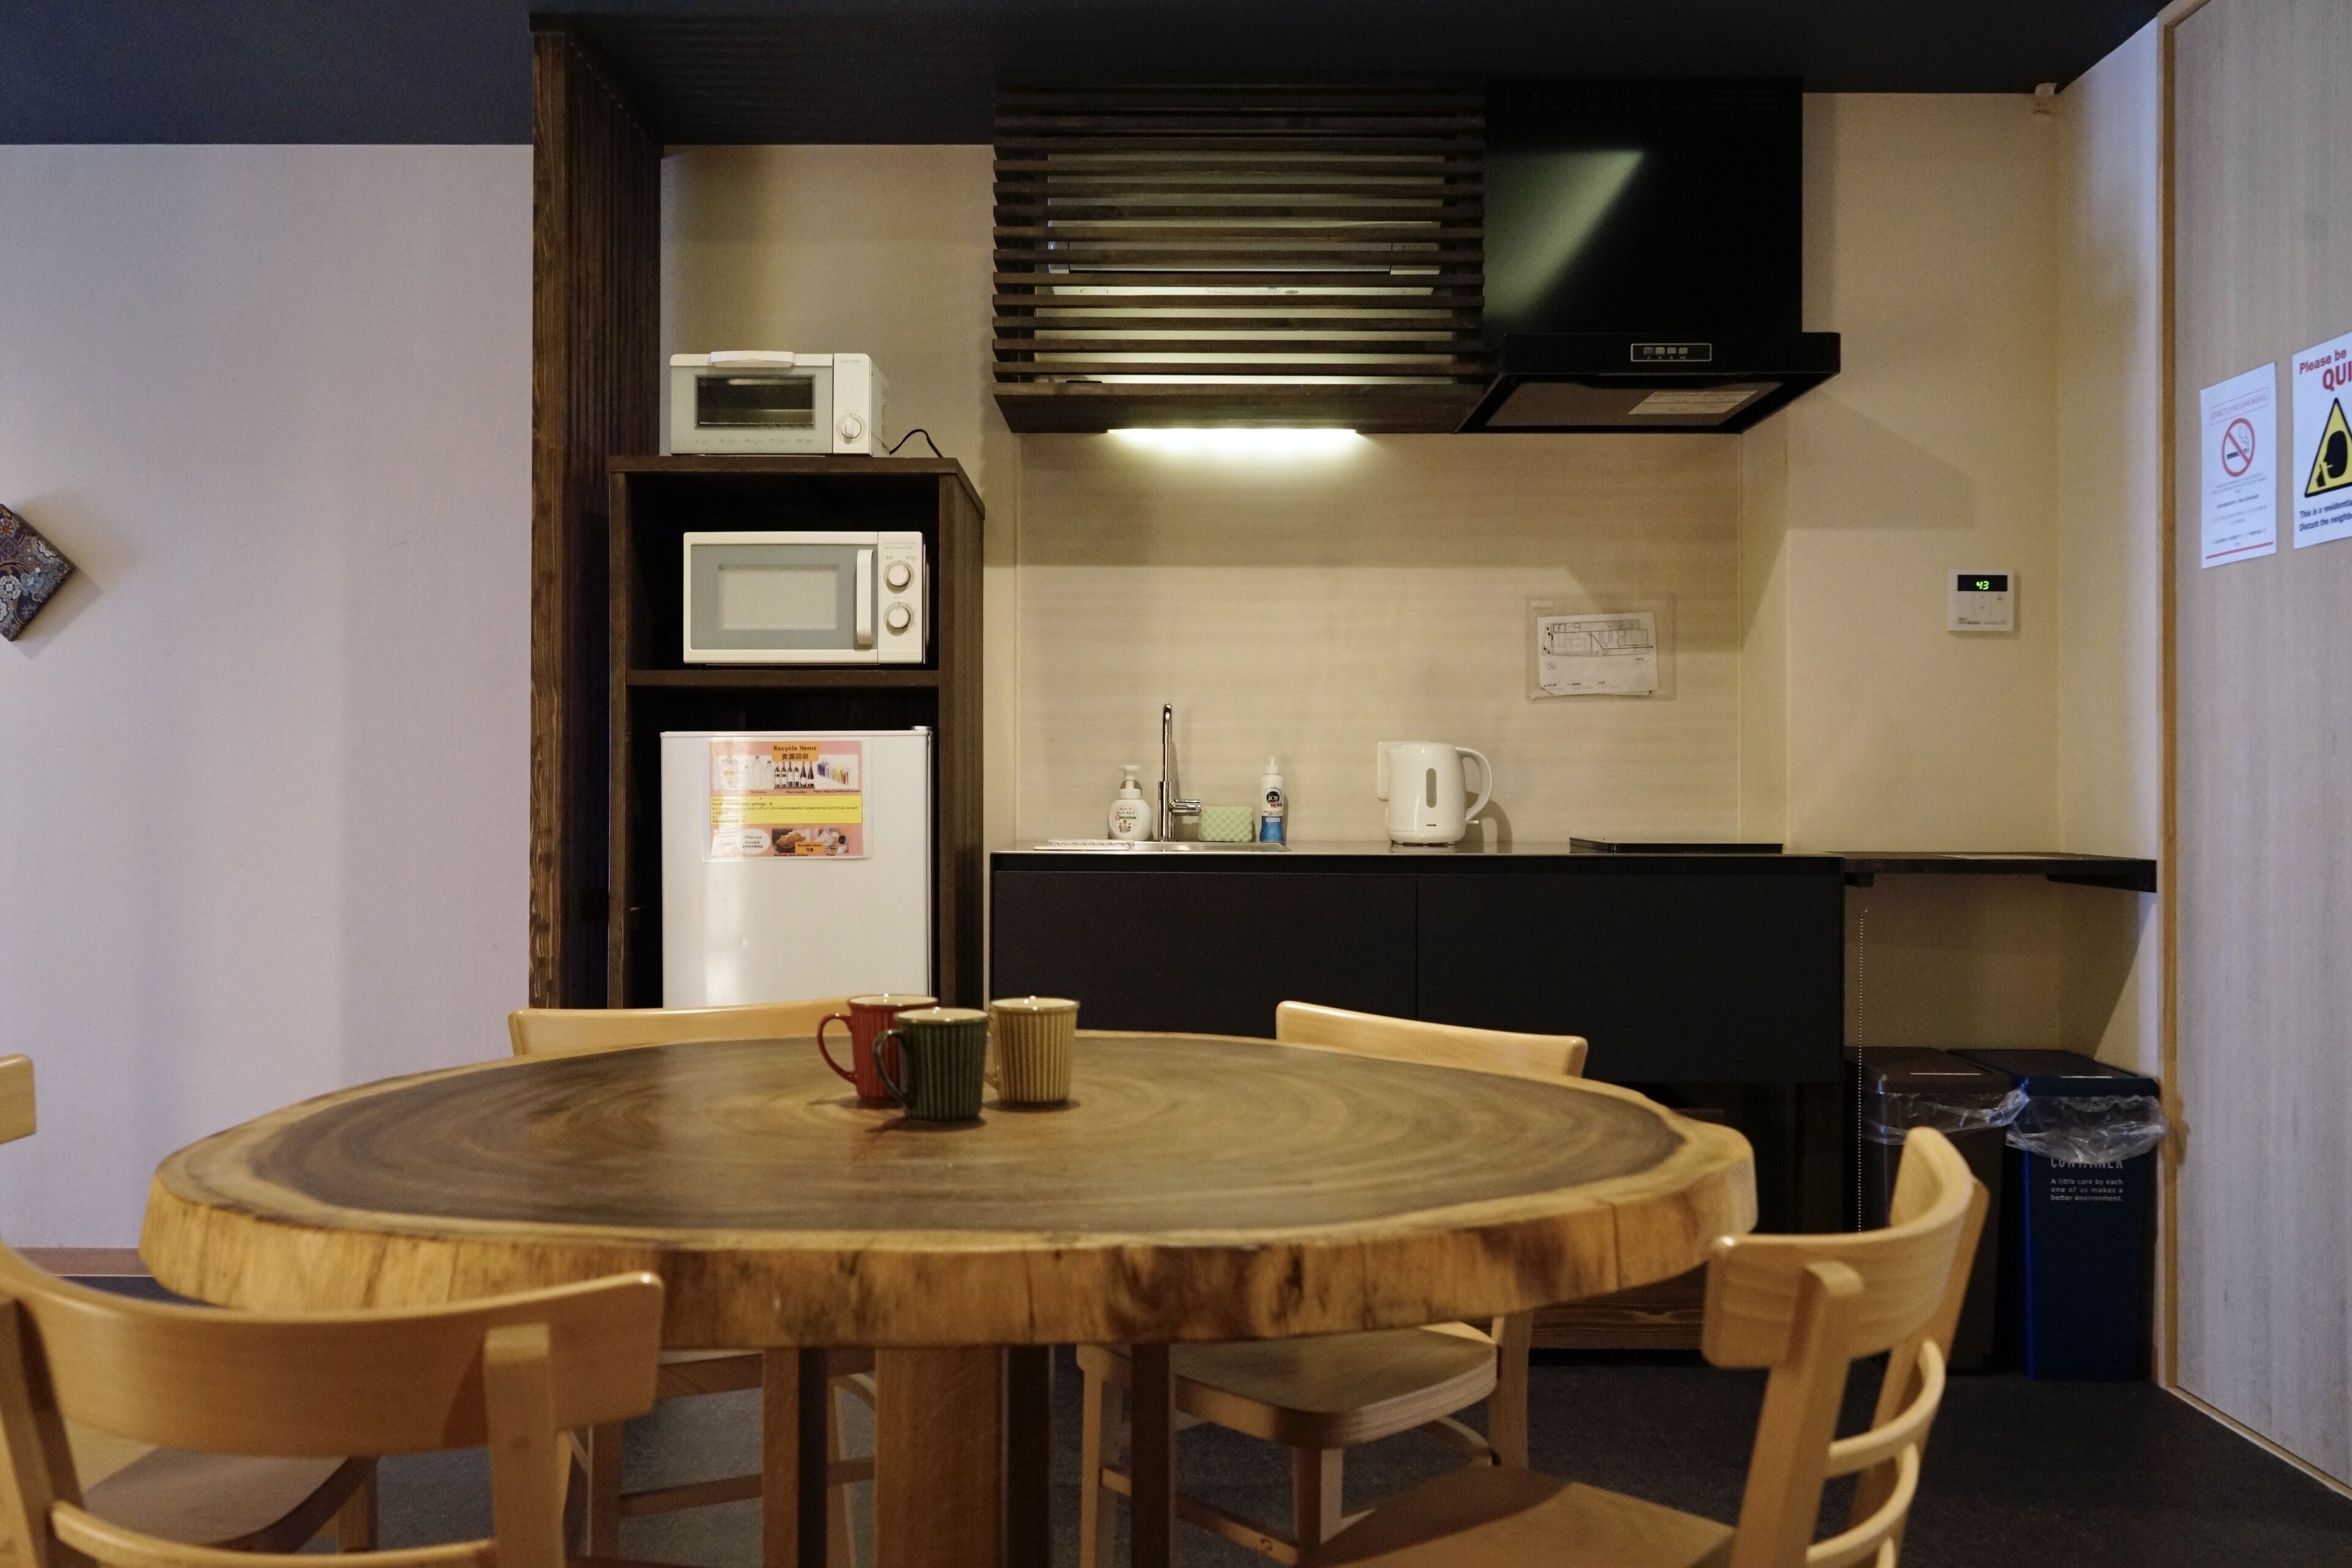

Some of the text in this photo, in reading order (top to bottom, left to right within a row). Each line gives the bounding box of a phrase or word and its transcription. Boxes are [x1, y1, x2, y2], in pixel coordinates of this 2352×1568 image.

[2299, 349, 2346, 375] Please be
[1975, 581, 1989, 590] 43
